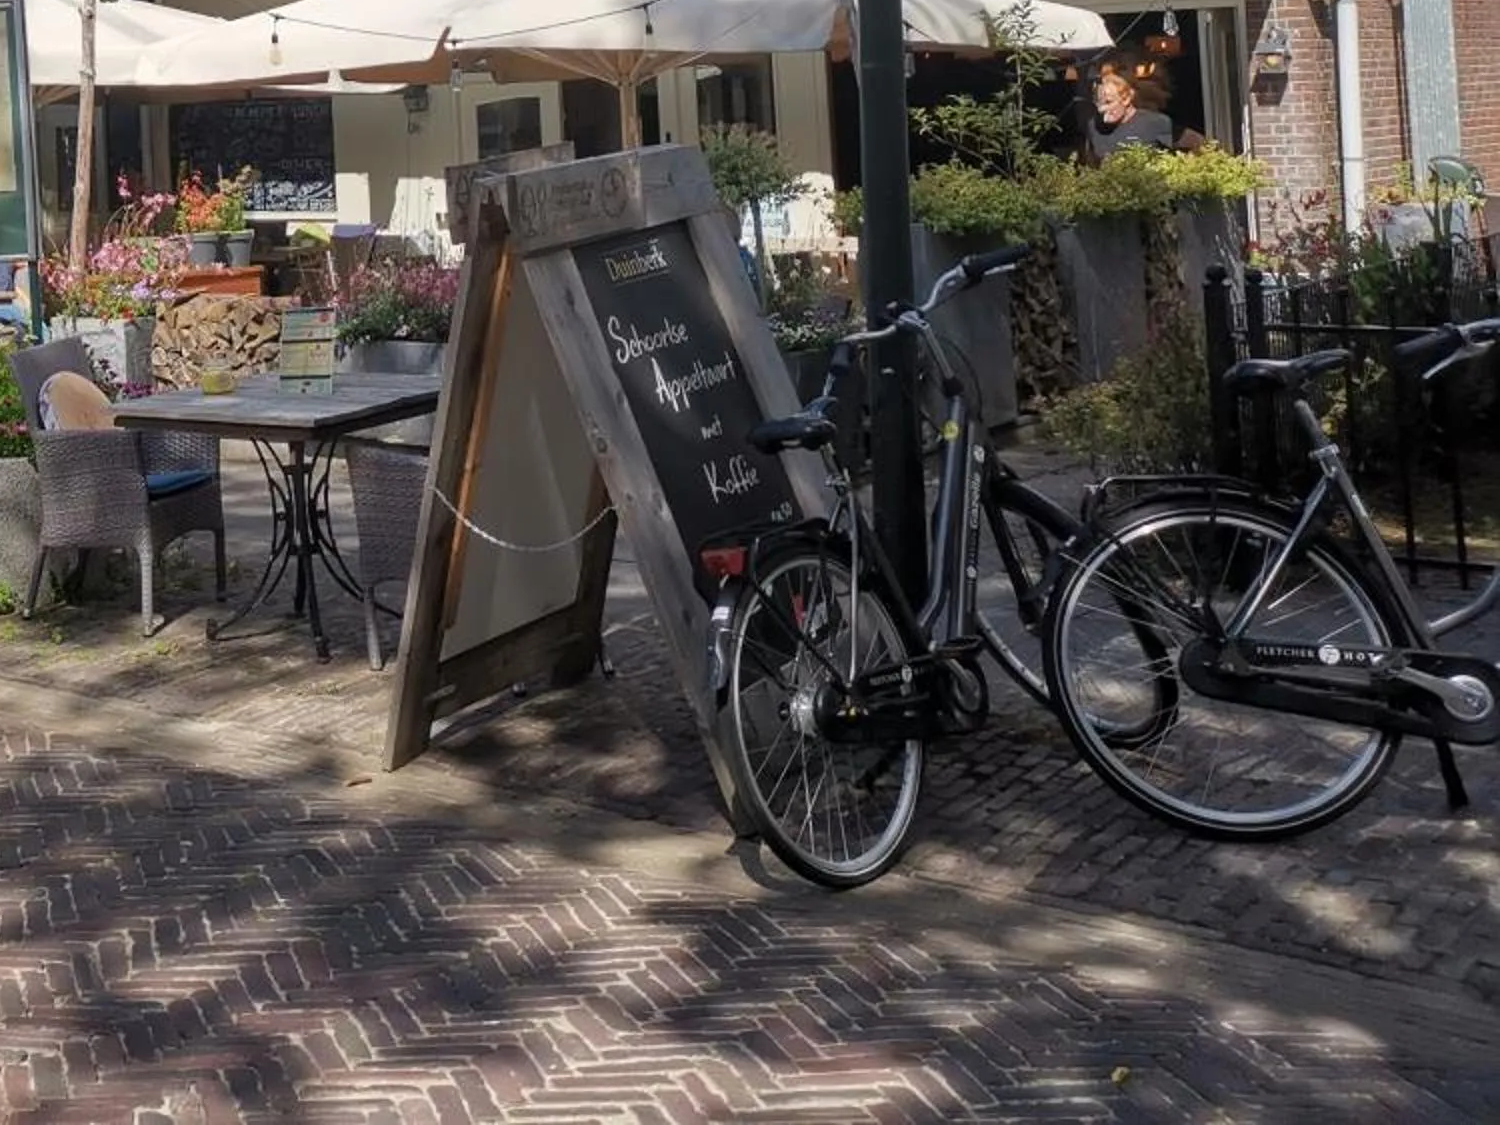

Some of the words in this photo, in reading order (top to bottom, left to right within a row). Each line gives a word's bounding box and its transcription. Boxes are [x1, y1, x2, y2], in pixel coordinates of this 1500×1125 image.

[607, 315, 690, 364] Schoorlse
[651, 351, 737, 413] Appeltaart
[701, 414, 724, 441] met
[703, 454, 761, 505] Koffie
[1256, 646, 1315, 658] FLETCHER
